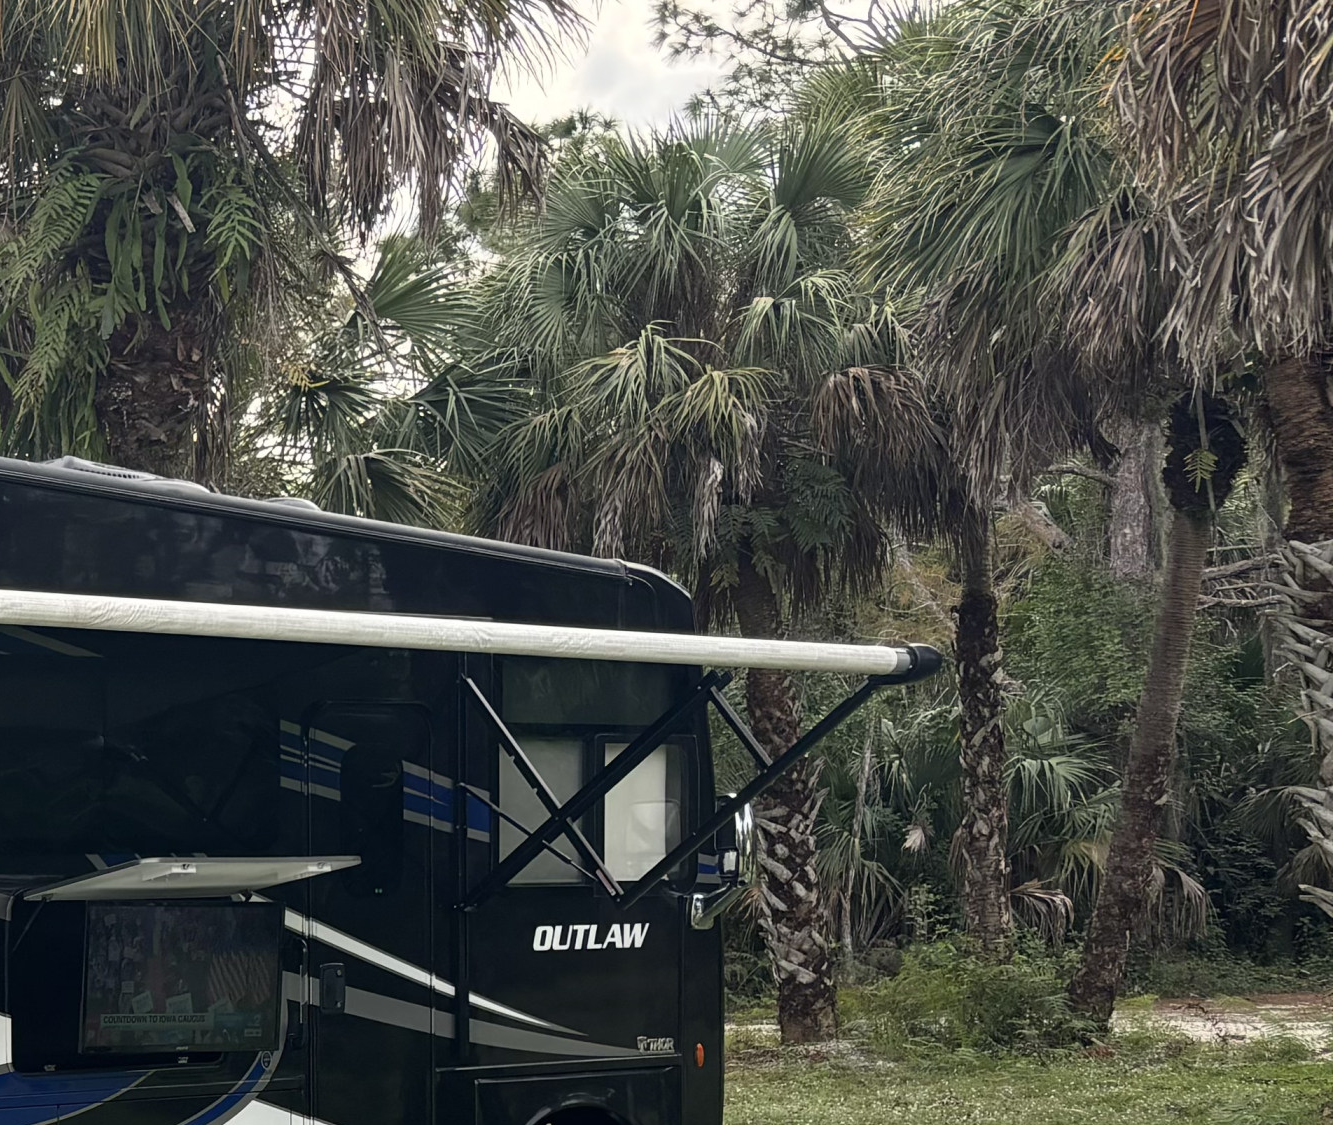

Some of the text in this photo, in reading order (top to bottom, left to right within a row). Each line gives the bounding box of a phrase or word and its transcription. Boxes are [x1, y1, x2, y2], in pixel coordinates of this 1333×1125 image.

[533, 922, 650, 951] OUTLAW
[103, 1015, 148, 1024] COUNTDOWN
[149, 1015, 158, 1023] TO
[647, 1037, 674, 1051] THOR
